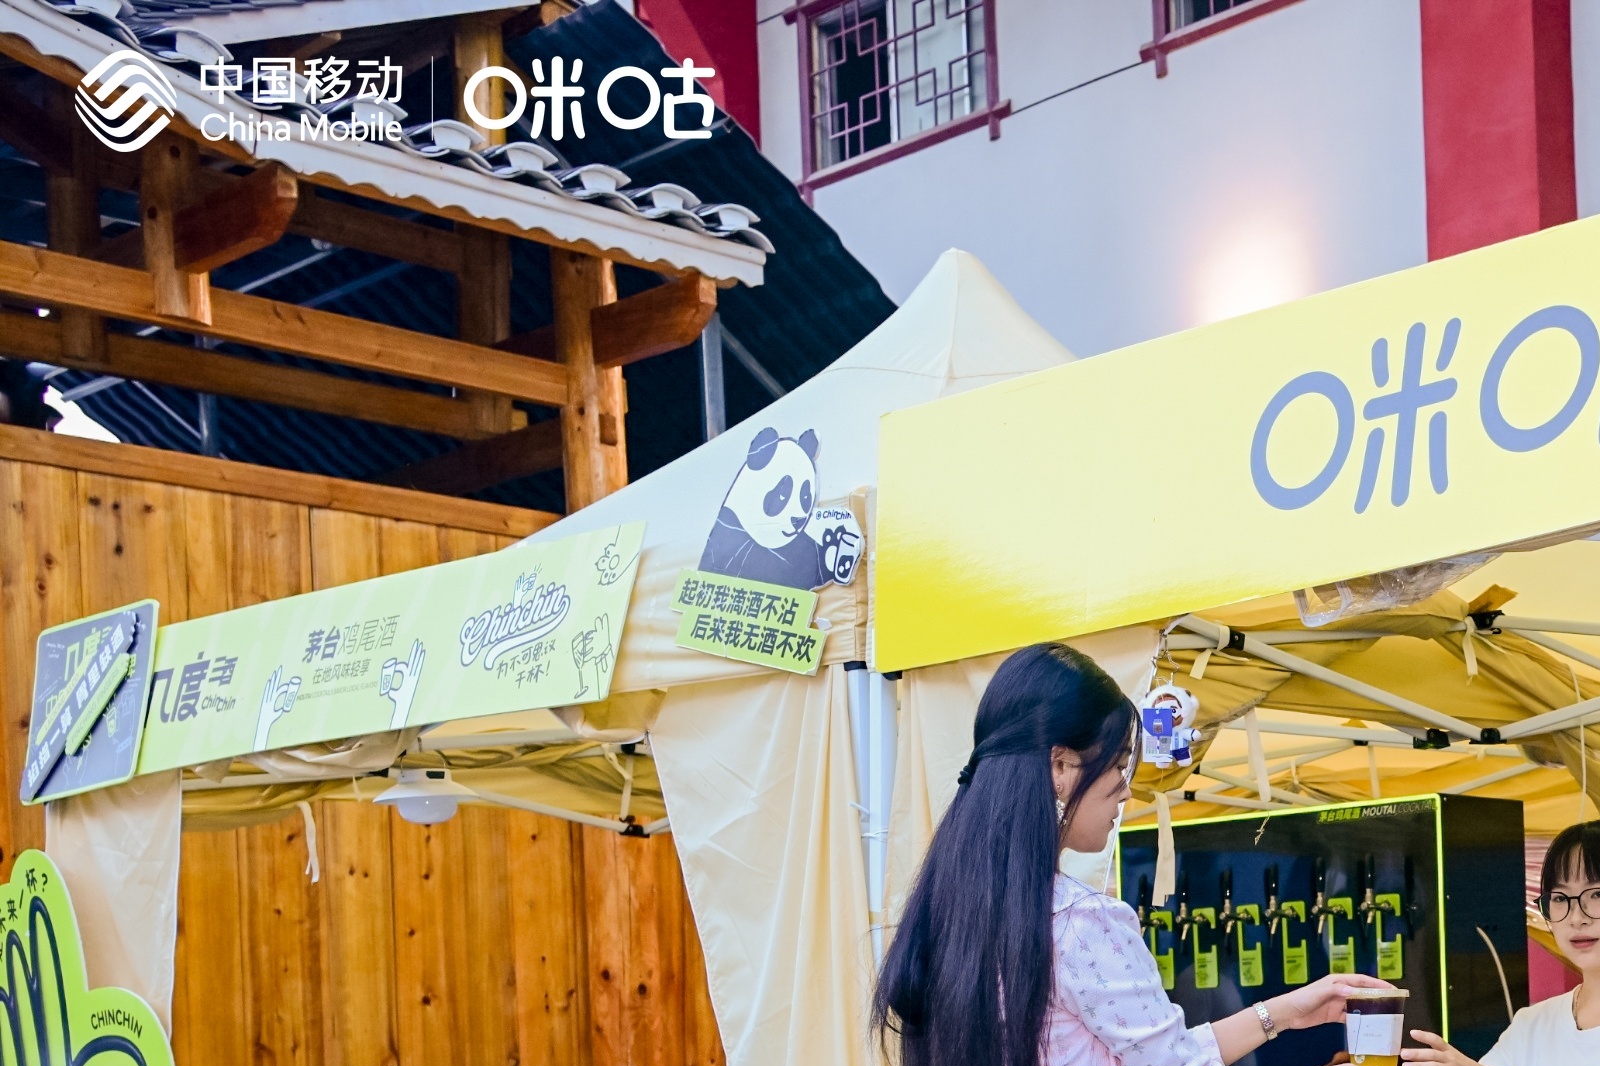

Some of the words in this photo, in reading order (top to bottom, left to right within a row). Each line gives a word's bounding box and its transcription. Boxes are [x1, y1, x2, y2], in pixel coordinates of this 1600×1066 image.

[678, 578, 799, 626] 起初我滴酒不沾
[302, 614, 400, 664] 茅台鸡尾酒
[690, 613, 817, 663] 后来我无酒不欢
[312, 658, 372, 686] 在地风味轻享
[1362, 804, 1397, 818] MOUTAI
[91, 1009, 143, 1038] CHINCHIN
